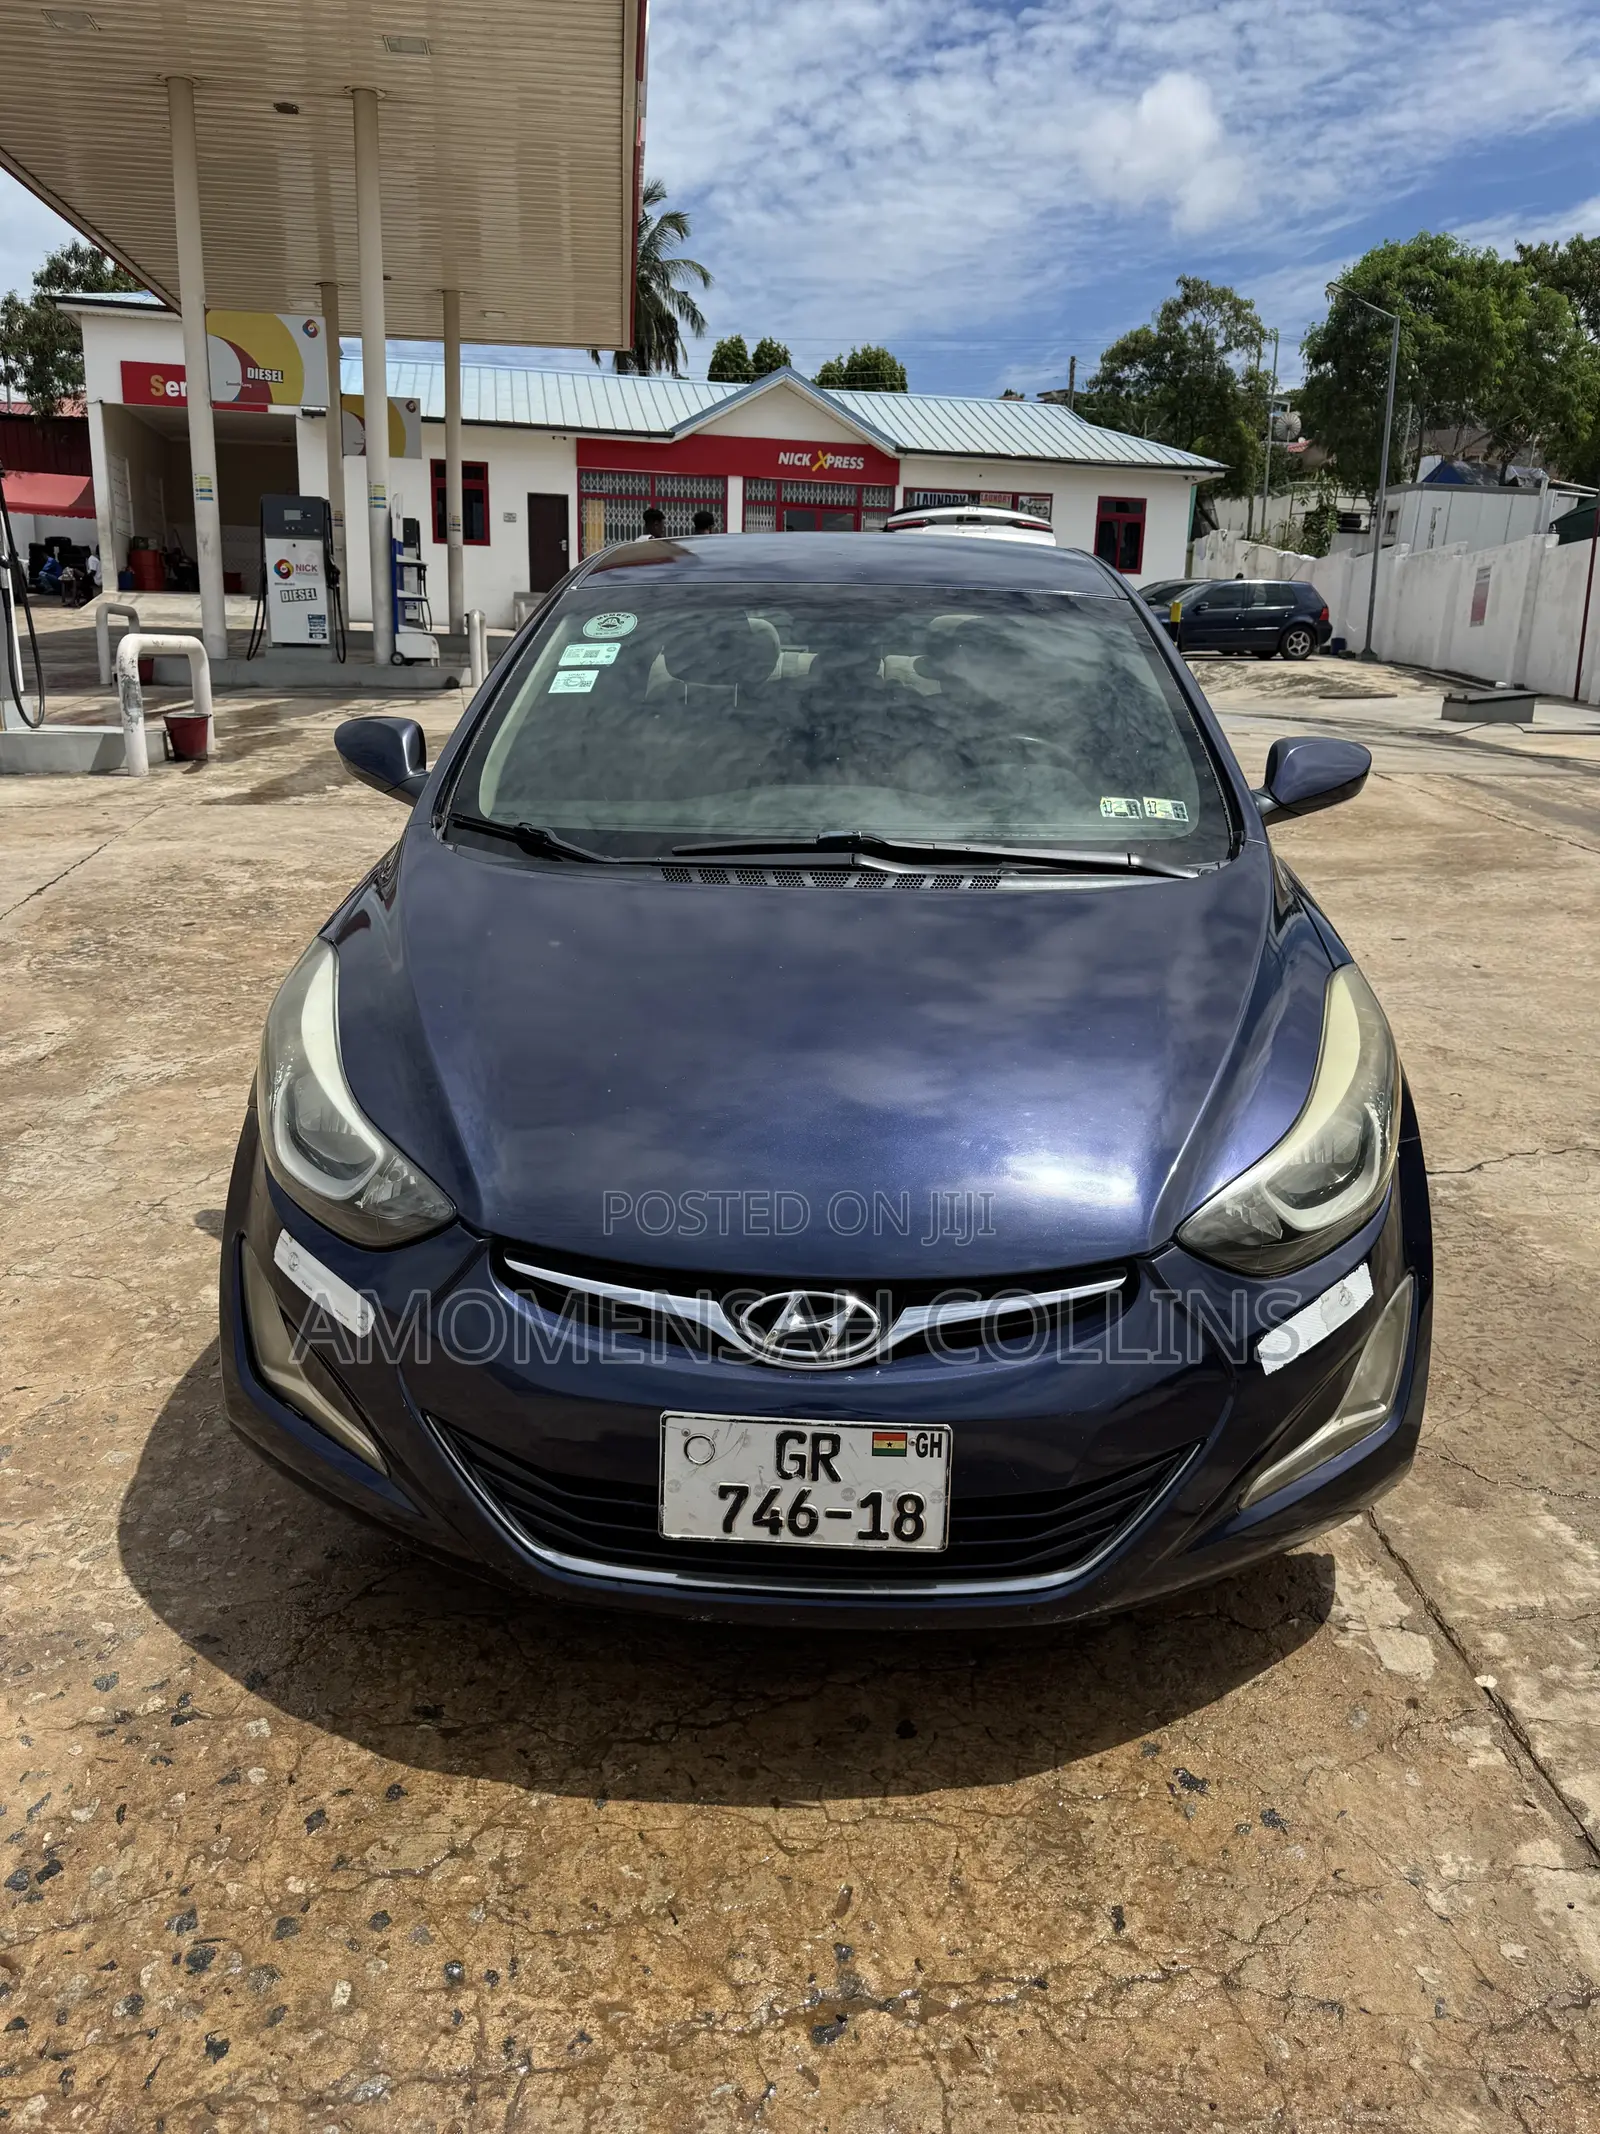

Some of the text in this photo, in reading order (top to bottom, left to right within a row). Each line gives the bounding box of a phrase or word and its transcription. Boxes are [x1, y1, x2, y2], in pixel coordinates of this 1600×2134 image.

[247, 367, 284, 383] DIESEL
[778, 449, 865, 472] NICK XPRESS
[295, 563, 318, 573] NICK
[281, 588, 317, 602] DIESEL
[775, 1429, 843, 1483] GR
[915, 1431, 943, 1458] GH
[717, 1481, 927, 1543] 746-18
